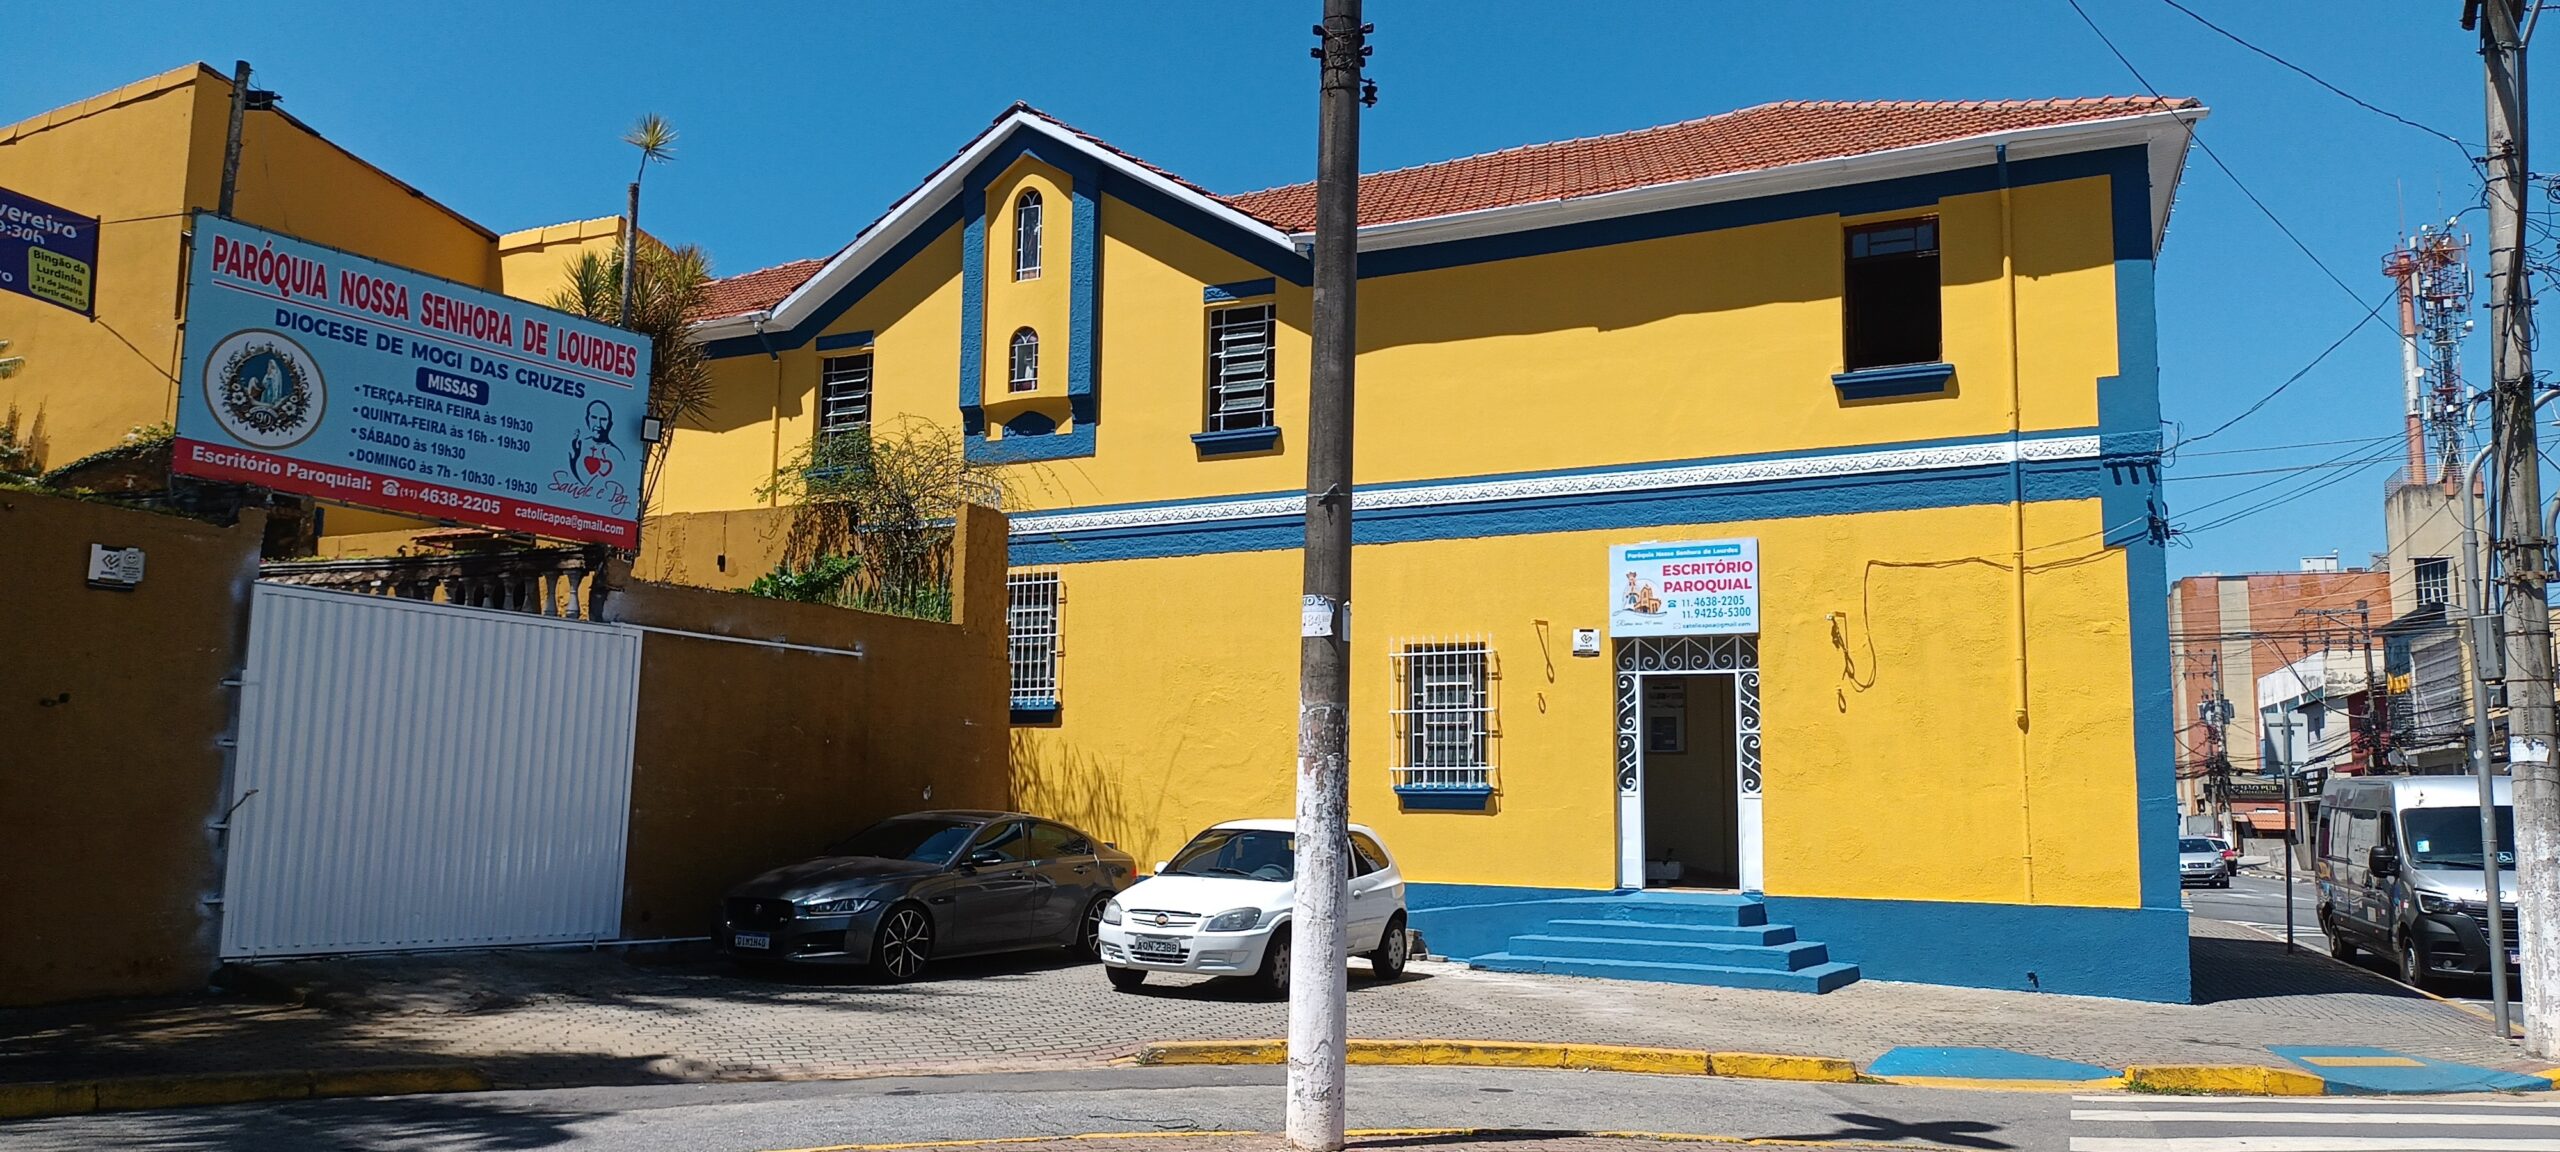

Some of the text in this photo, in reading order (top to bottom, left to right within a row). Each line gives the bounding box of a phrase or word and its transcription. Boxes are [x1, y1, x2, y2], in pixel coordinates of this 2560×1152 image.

[33, 250, 86, 275] Bingão da
[36, 264, 83, 286] Lurdinha
[38, 285, 59, 297] partir
[61, 291, 73, 303] das
[47, 277, 57, 286] de
[212, 235, 637, 378] PARÓQUIA NOSSA SENHORA DE LOURDES
[275, 308, 586, 399] DIOCESE DE MOGI DAS CRUZES
[427, 373, 478, 399] MISSAS
[362, 384, 533, 433] TERÇA-FEIRA FEIRA às 19h30
[358, 426, 466, 460] SÁBADO às 19h30
[360, 406, 447, 435] QUINTA-FEIRA
[450, 425, 463, 438] às
[467, 429, 487, 444] 16h
[498, 435, 530, 453] 19h30
[356, 448, 416, 472] DOMINGO
[419, 460, 433, 475] às
[437, 464, 450, 478] 7h
[461, 469, 495, 487] 10h30
[505, 477, 538, 495] 19h30
[192, 445, 625, 536] Escritório Paroquial: (11) 4638-2205 catolicapoa@gmail.com
[547, 471, 631, 515] Saúde e Paz
[1662, 559, 1753, 577] ESCRITÓRIO
[1663, 578, 1752, 593] PAROQUIAL
